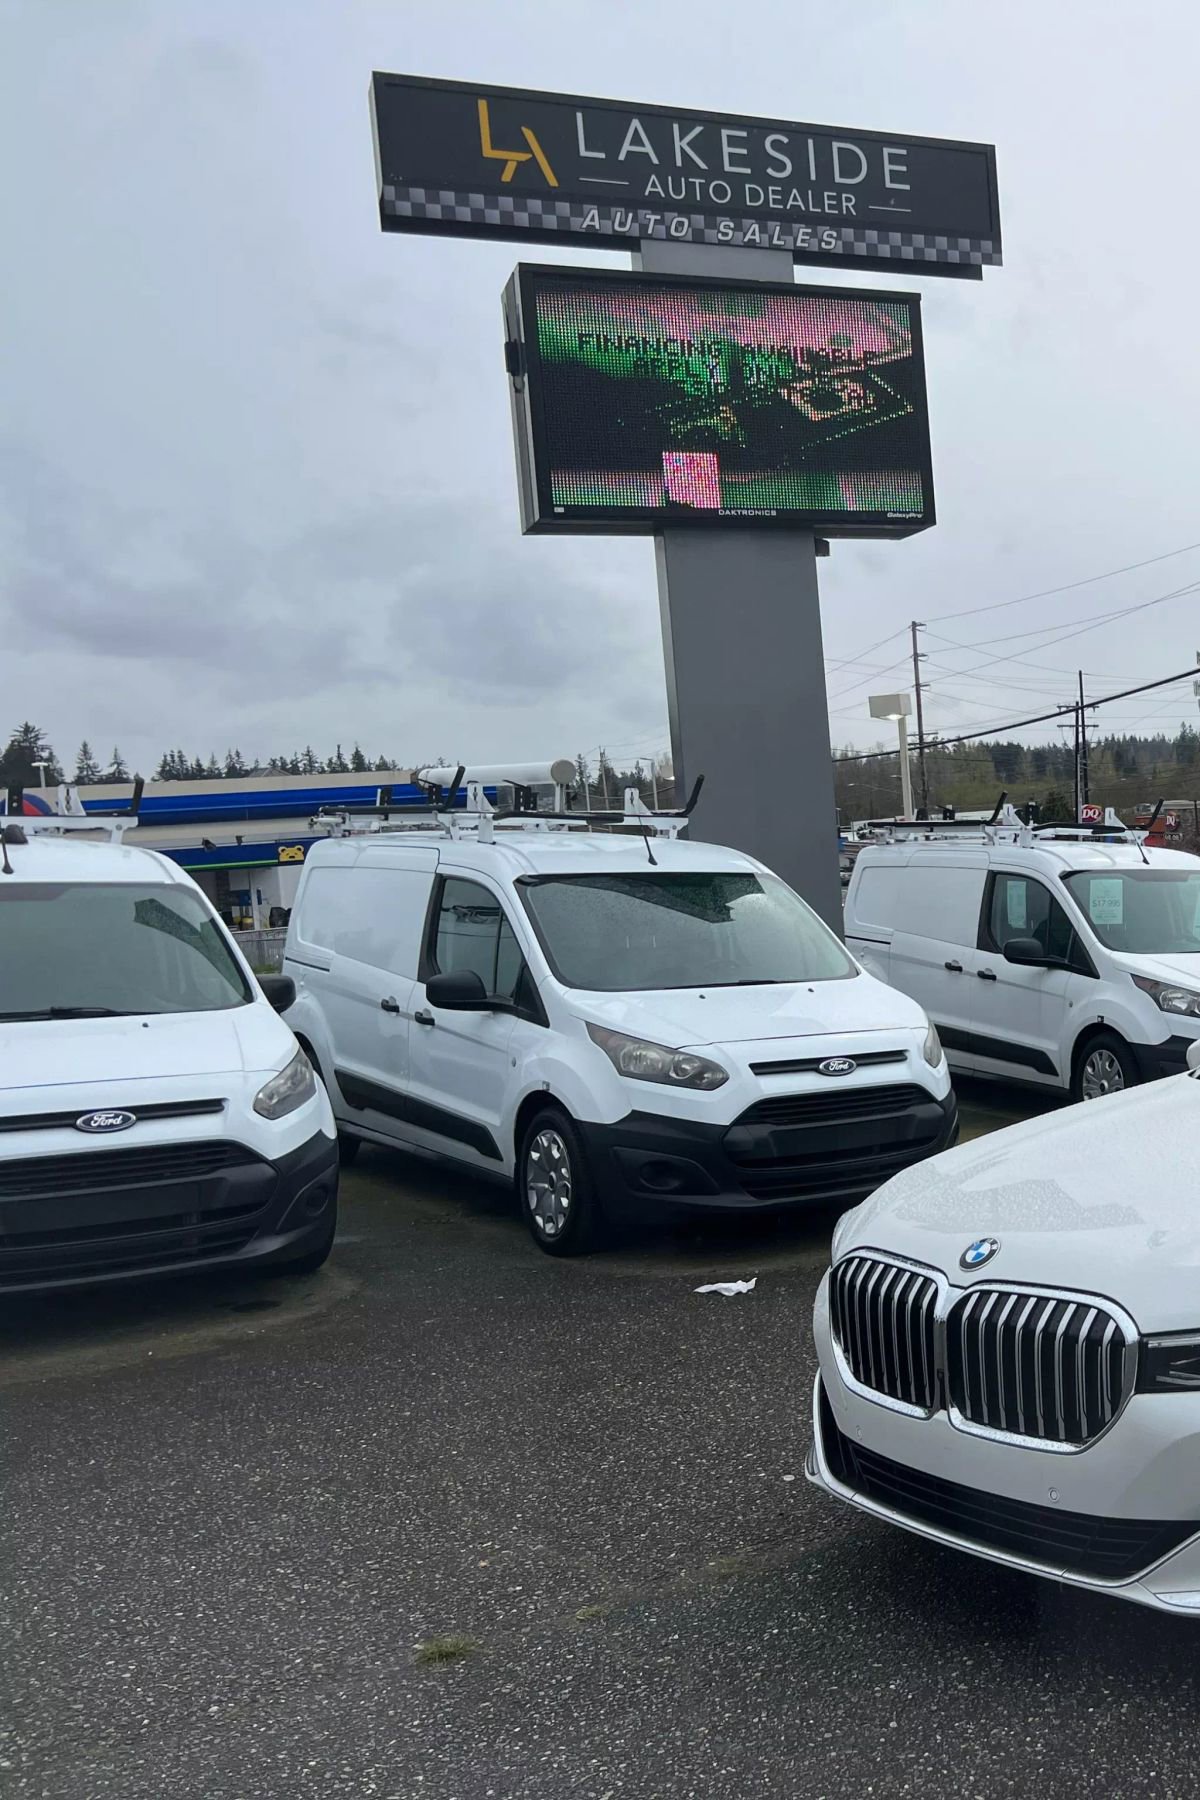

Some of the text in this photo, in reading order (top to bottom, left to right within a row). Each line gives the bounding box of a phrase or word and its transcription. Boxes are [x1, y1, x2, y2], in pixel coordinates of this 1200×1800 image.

[575, 111, 911, 191] LAKESIDE
[644, 174, 857, 216] AUTO DEALER
[581, 209, 838, 250] AUTO SALES
[577, 332, 722, 358] FINANCING
[718, 509, 777, 517] DAKTRONICS
[1082, 808, 1099, 819] DQ
[828, 1060, 850, 1071] Ford
[90, 1113, 123, 1127] Ford
